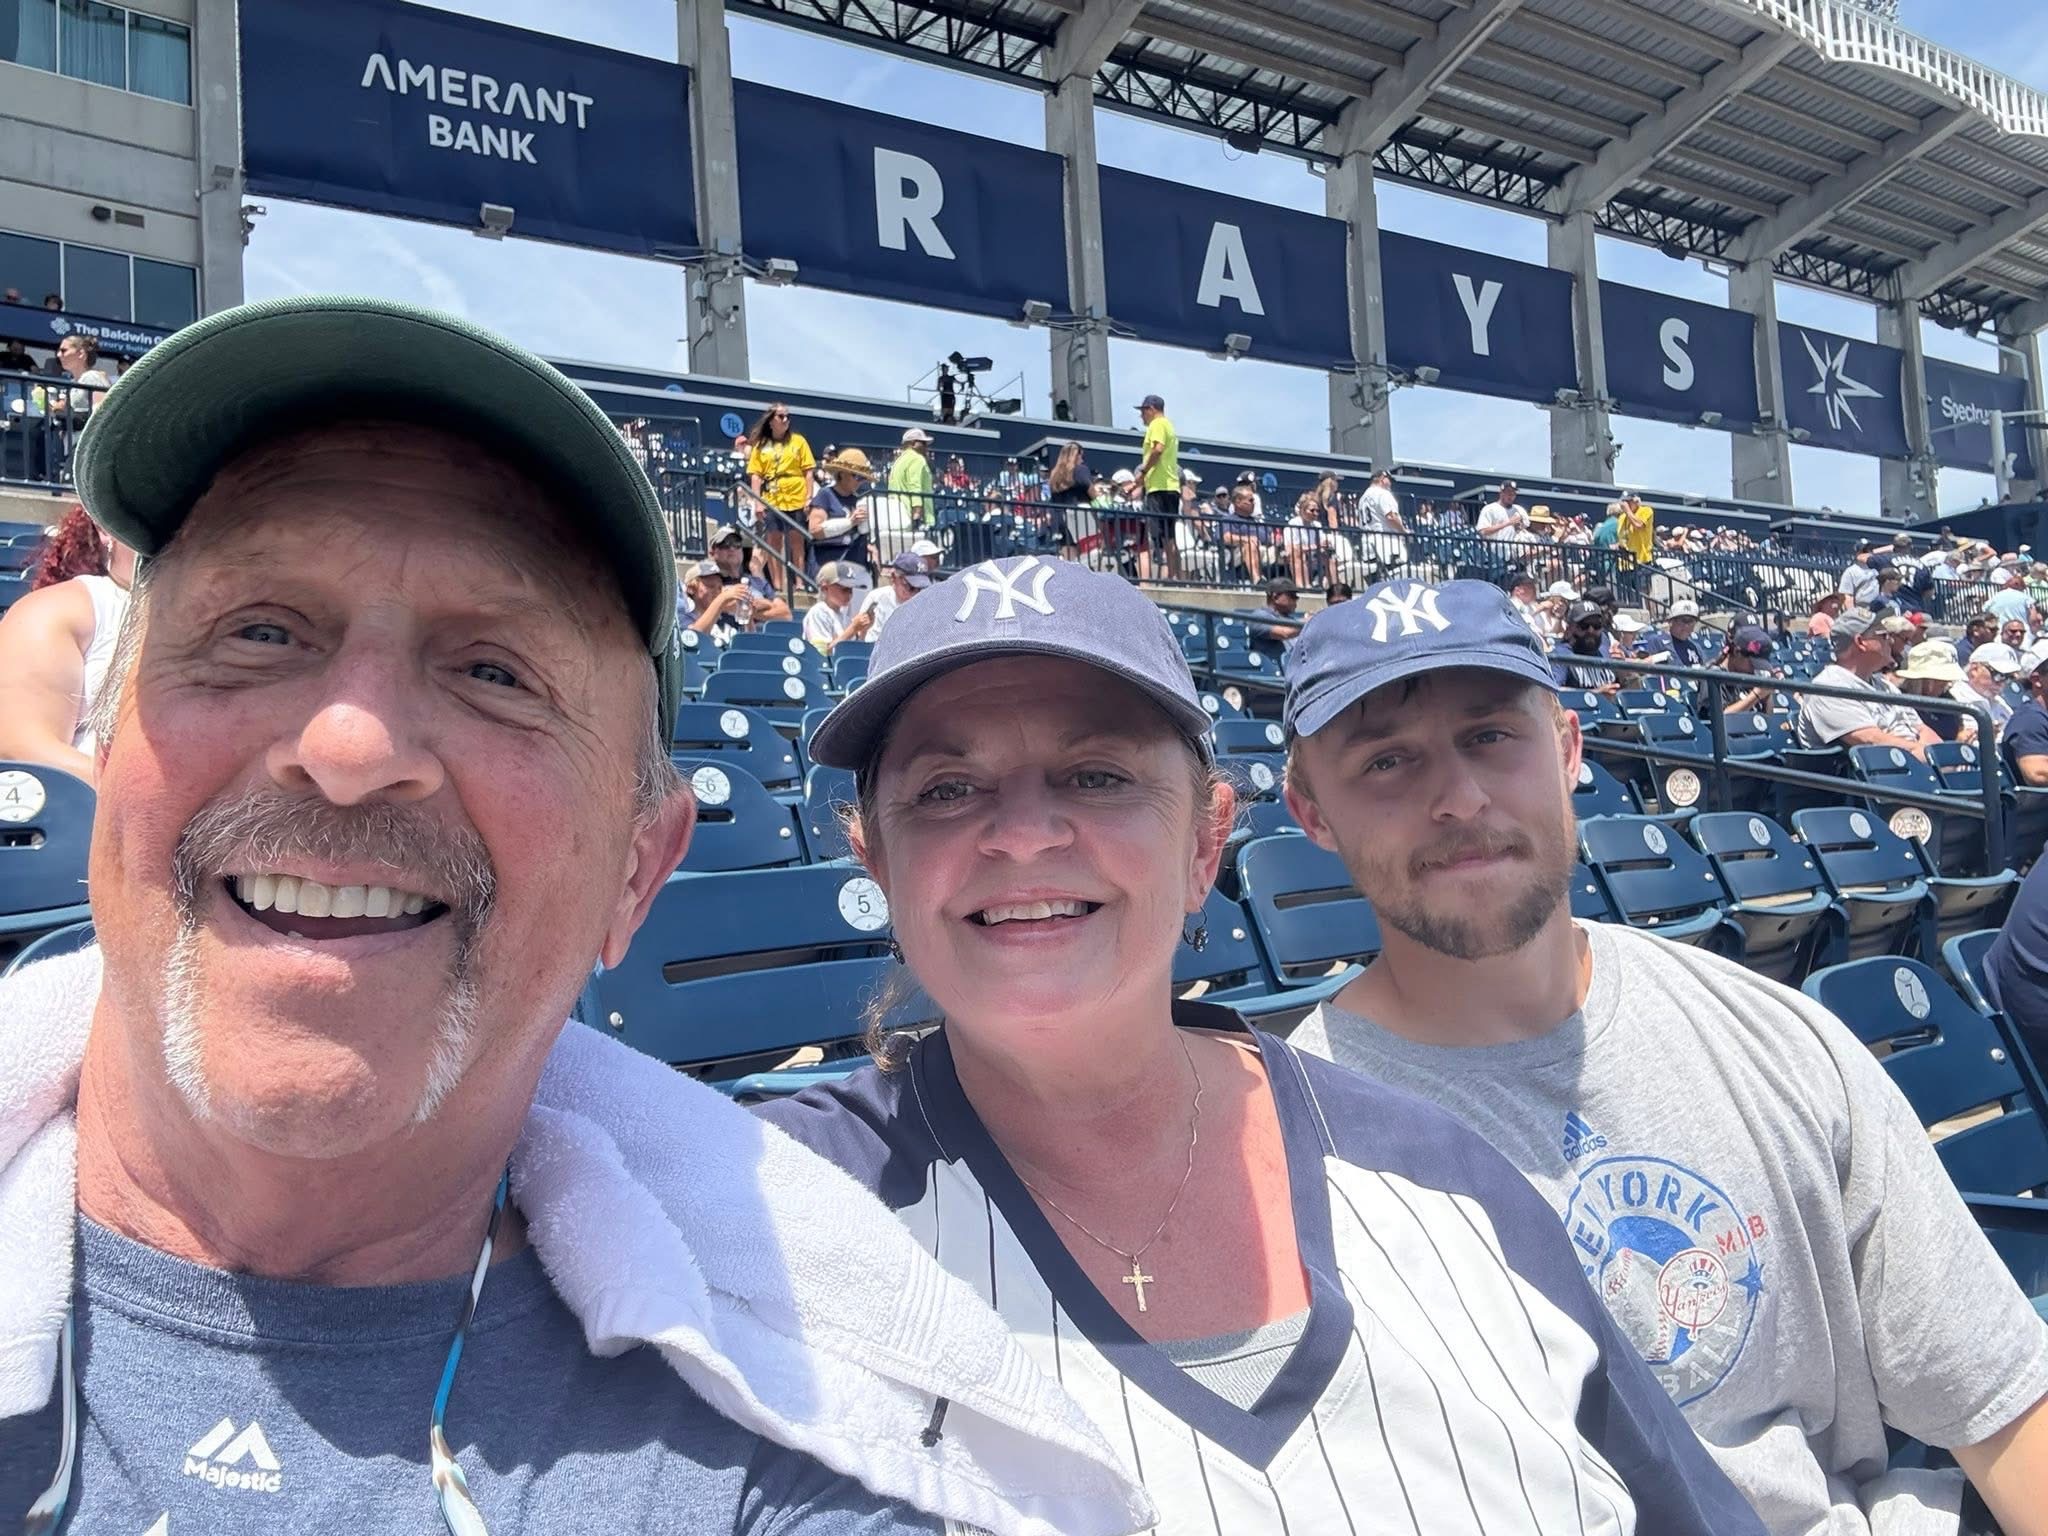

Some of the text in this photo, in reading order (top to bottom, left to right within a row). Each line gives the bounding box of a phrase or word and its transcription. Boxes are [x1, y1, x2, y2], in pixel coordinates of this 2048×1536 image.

[361, 53, 594, 129] AMERANT
[428, 114, 538, 164] BANK
[74, 322, 99, 337] The
[101, 327, 153, 345] Baldwin
[1941, 395, 1992, 425] Spectru
[954, 555, 1056, 622] NY
[1366, 583, 1451, 643] NY
[5, 787, 21, 804] 4
[706, 777, 716, 793] 6
[857, 894, 871, 914] 5
[1904, 983, 1915, 1002] 7
[1563, 1135, 1607, 1161] adidas
[1597, 1171, 1720, 1233] YORK
[1715, 1214, 1767, 1257] MLB
[183, 1457, 282, 1493] Majestic
